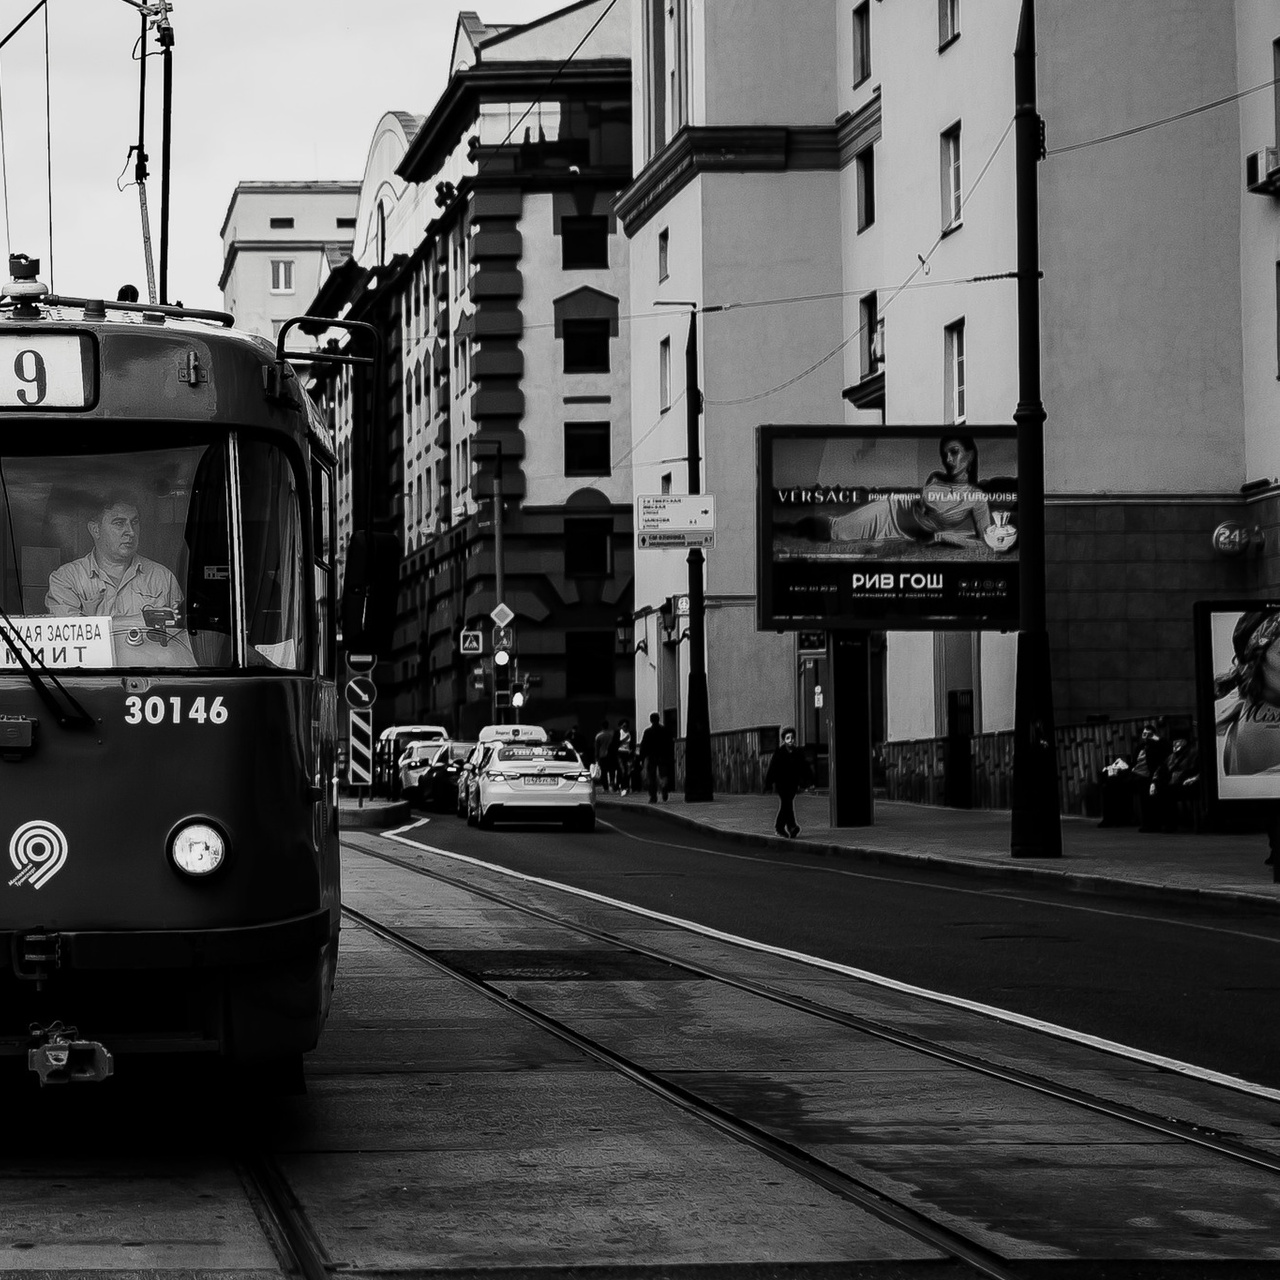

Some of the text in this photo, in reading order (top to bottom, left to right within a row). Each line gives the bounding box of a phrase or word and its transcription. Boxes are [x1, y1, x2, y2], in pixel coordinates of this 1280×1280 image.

[14, 349, 47, 405] 9
[778, 489, 861, 504] VERSACE
[928, 491, 961, 502] DYLAN
[852, 573, 895, 590] РИВ
[899, 573, 944, 590] ГОШ
[47, 623, 102, 642] ЗАСТАВА
[5, 646, 87, 664] МИИТ
[124, 696, 229, 724] 30146
